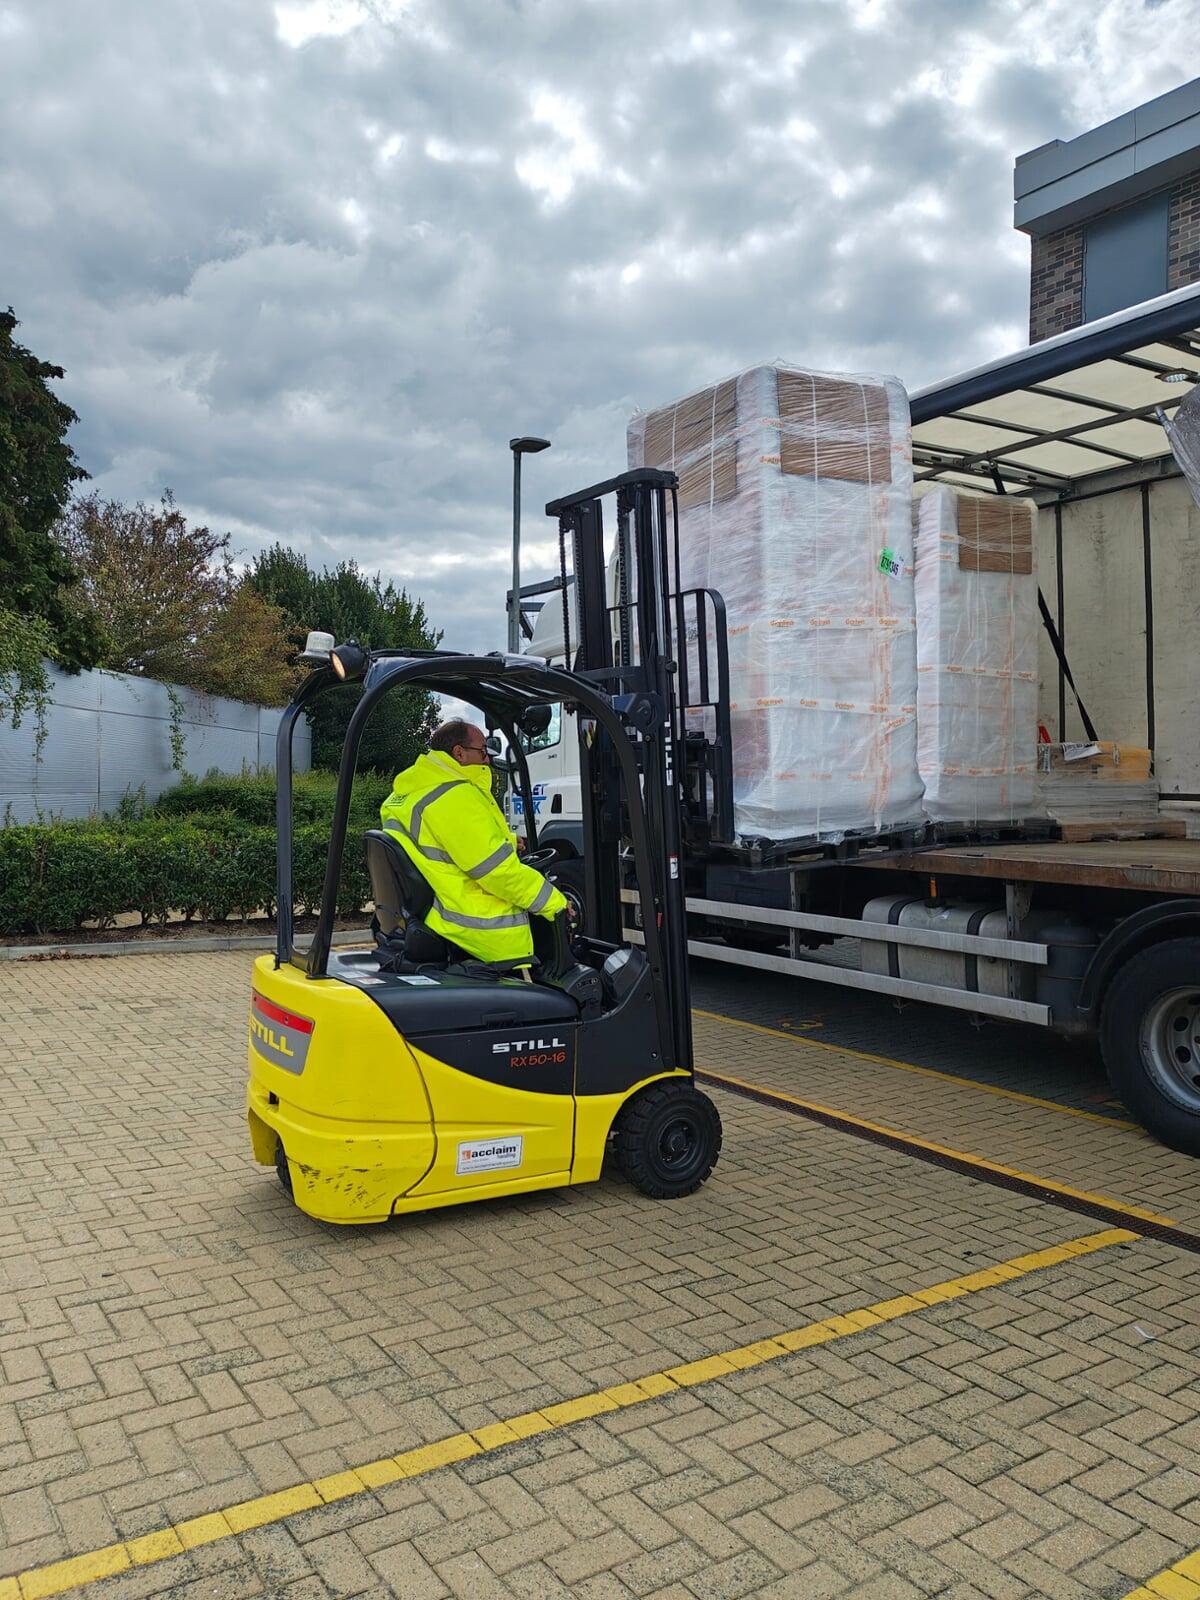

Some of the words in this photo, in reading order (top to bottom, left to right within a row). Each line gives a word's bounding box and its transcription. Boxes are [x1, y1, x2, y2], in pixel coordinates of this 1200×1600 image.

[664, 713, 673, 786] STILL
[492, 1037, 566, 1054] STILL
[471, 1145, 517, 1158] acclaim
